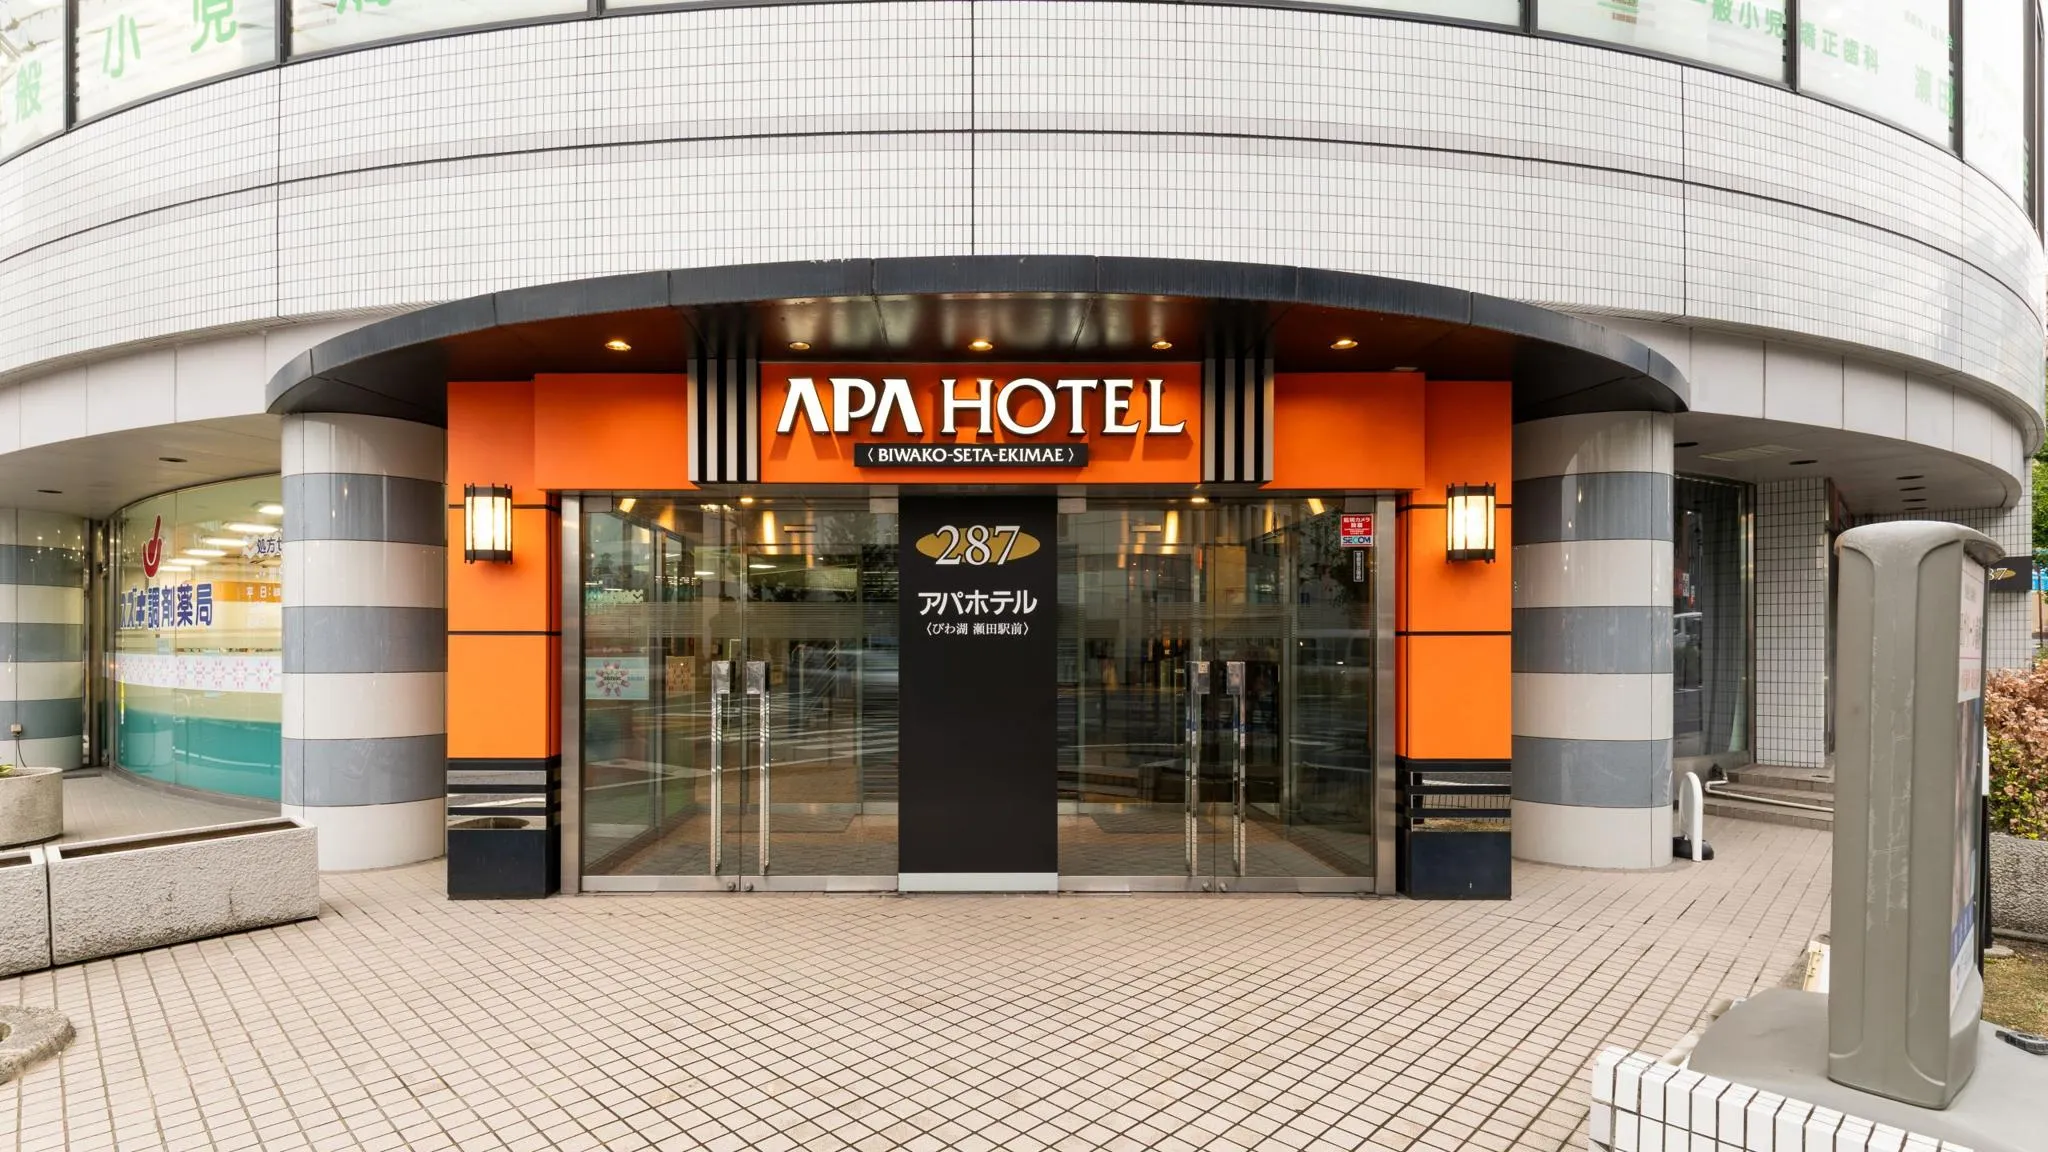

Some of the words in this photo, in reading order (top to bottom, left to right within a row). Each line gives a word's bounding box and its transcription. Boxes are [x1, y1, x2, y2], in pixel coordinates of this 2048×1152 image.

[776, 377, 924, 434] APA
[941, 377, 1187, 434] HOTEL
[935, 525, 1020, 565] 287
[1343, 536, 1371, 544] SECOM
[918, 589, 1038, 615] アパホテル
